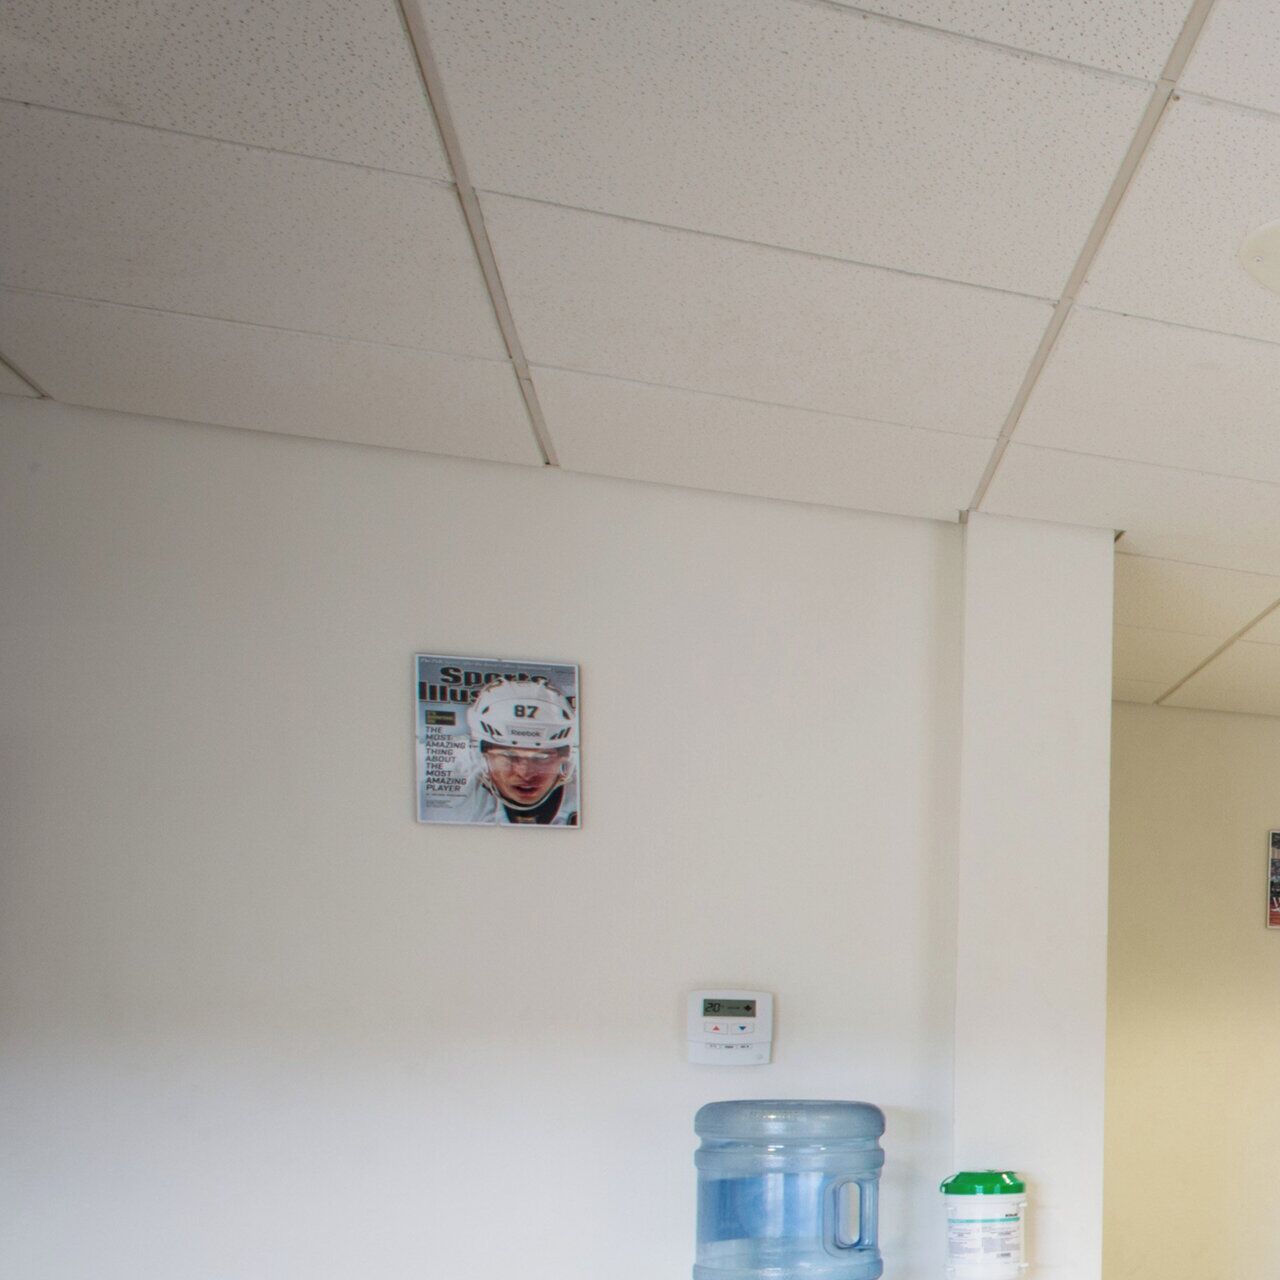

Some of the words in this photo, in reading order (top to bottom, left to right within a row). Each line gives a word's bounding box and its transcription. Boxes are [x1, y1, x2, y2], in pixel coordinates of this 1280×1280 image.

[514, 704, 540, 719] 87
[511, 729, 540, 737] Reebok
[426, 741, 466, 749] AMAZING
[426, 777, 467, 785] AMAZING
[426, 784, 461, 792] PLAYER
